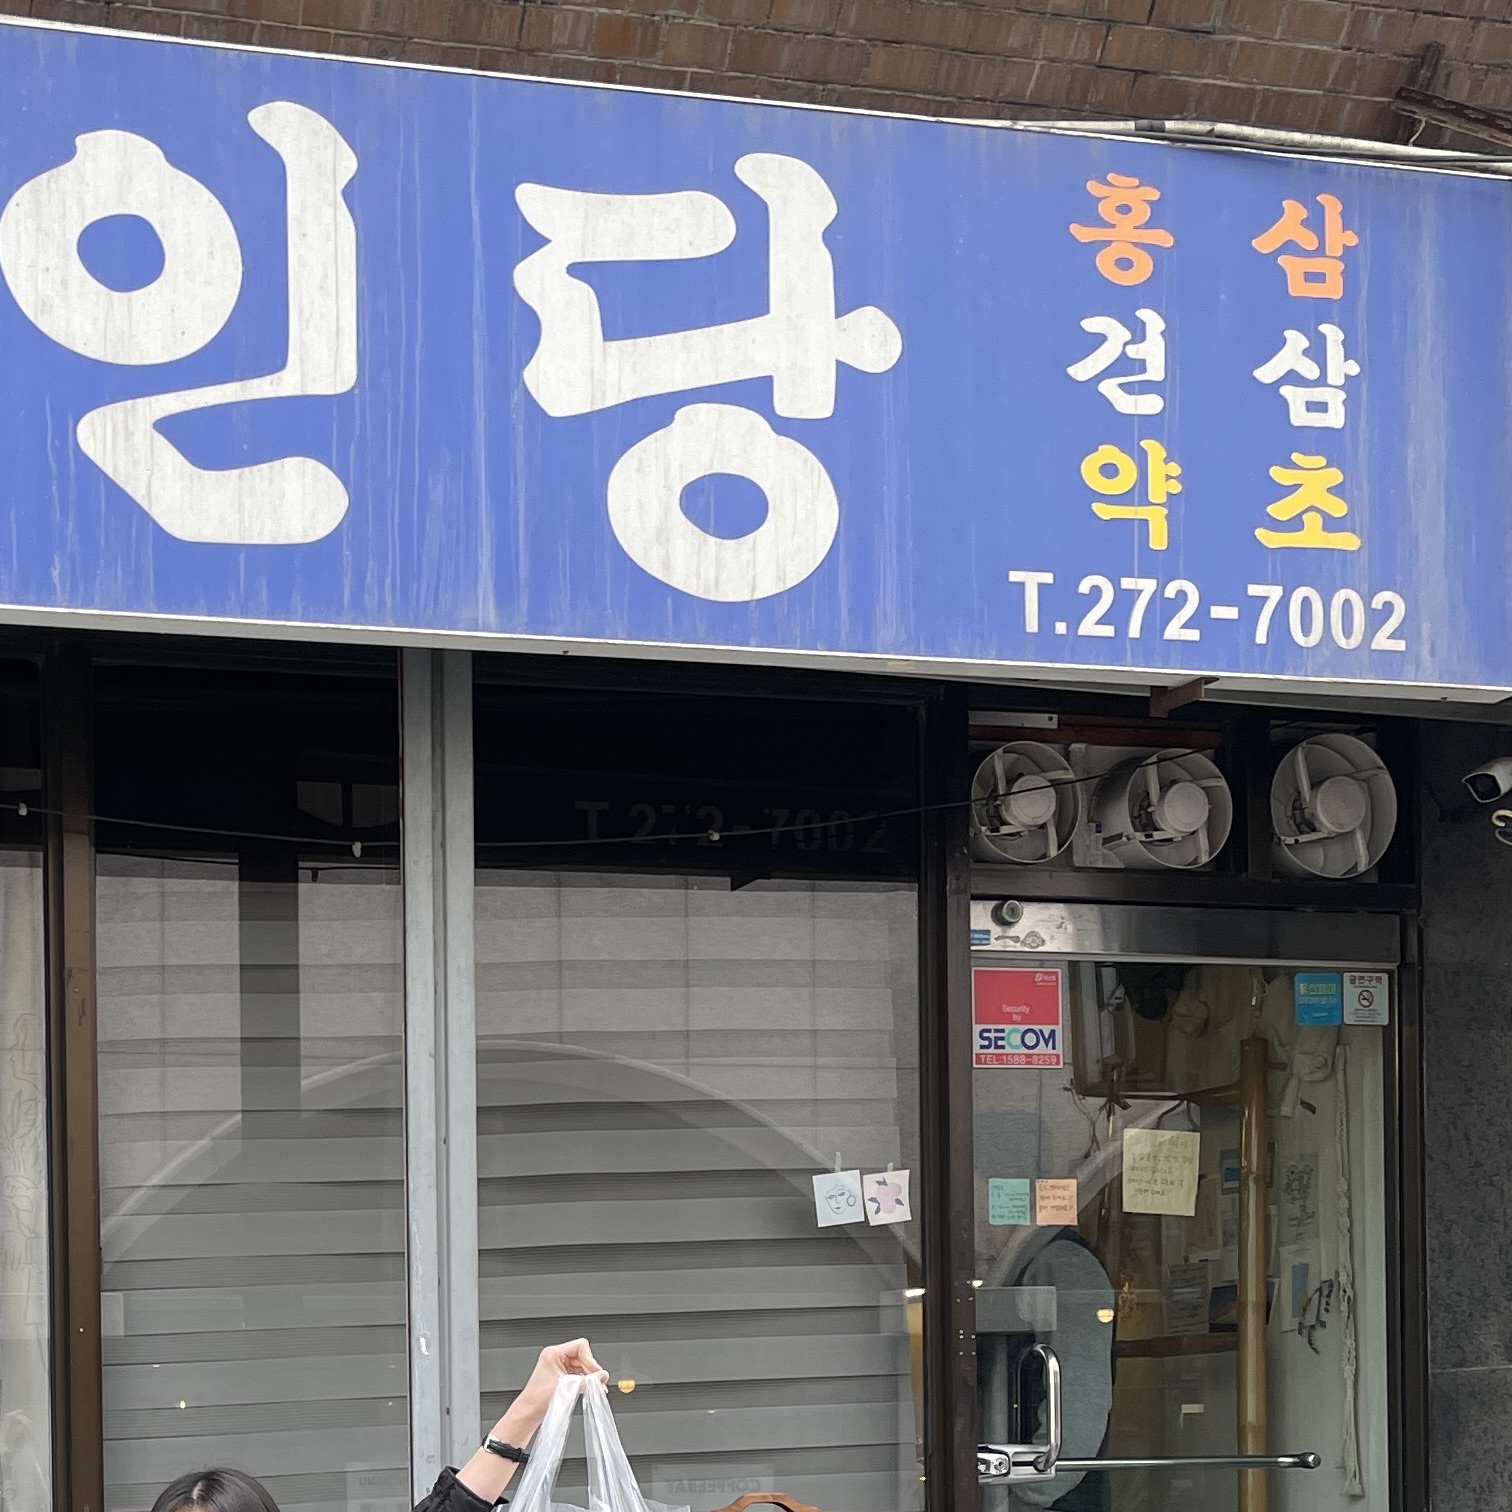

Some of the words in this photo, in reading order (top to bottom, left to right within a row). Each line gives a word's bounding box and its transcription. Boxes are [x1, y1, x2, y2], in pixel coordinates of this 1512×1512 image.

[1068, 172, 1360, 300] 홍삼
[1079, 438, 1362, 551] 약초
[1007, 570, 1408, 652] T.272-7002
[978, 1027, 1057, 1051] SECOM
